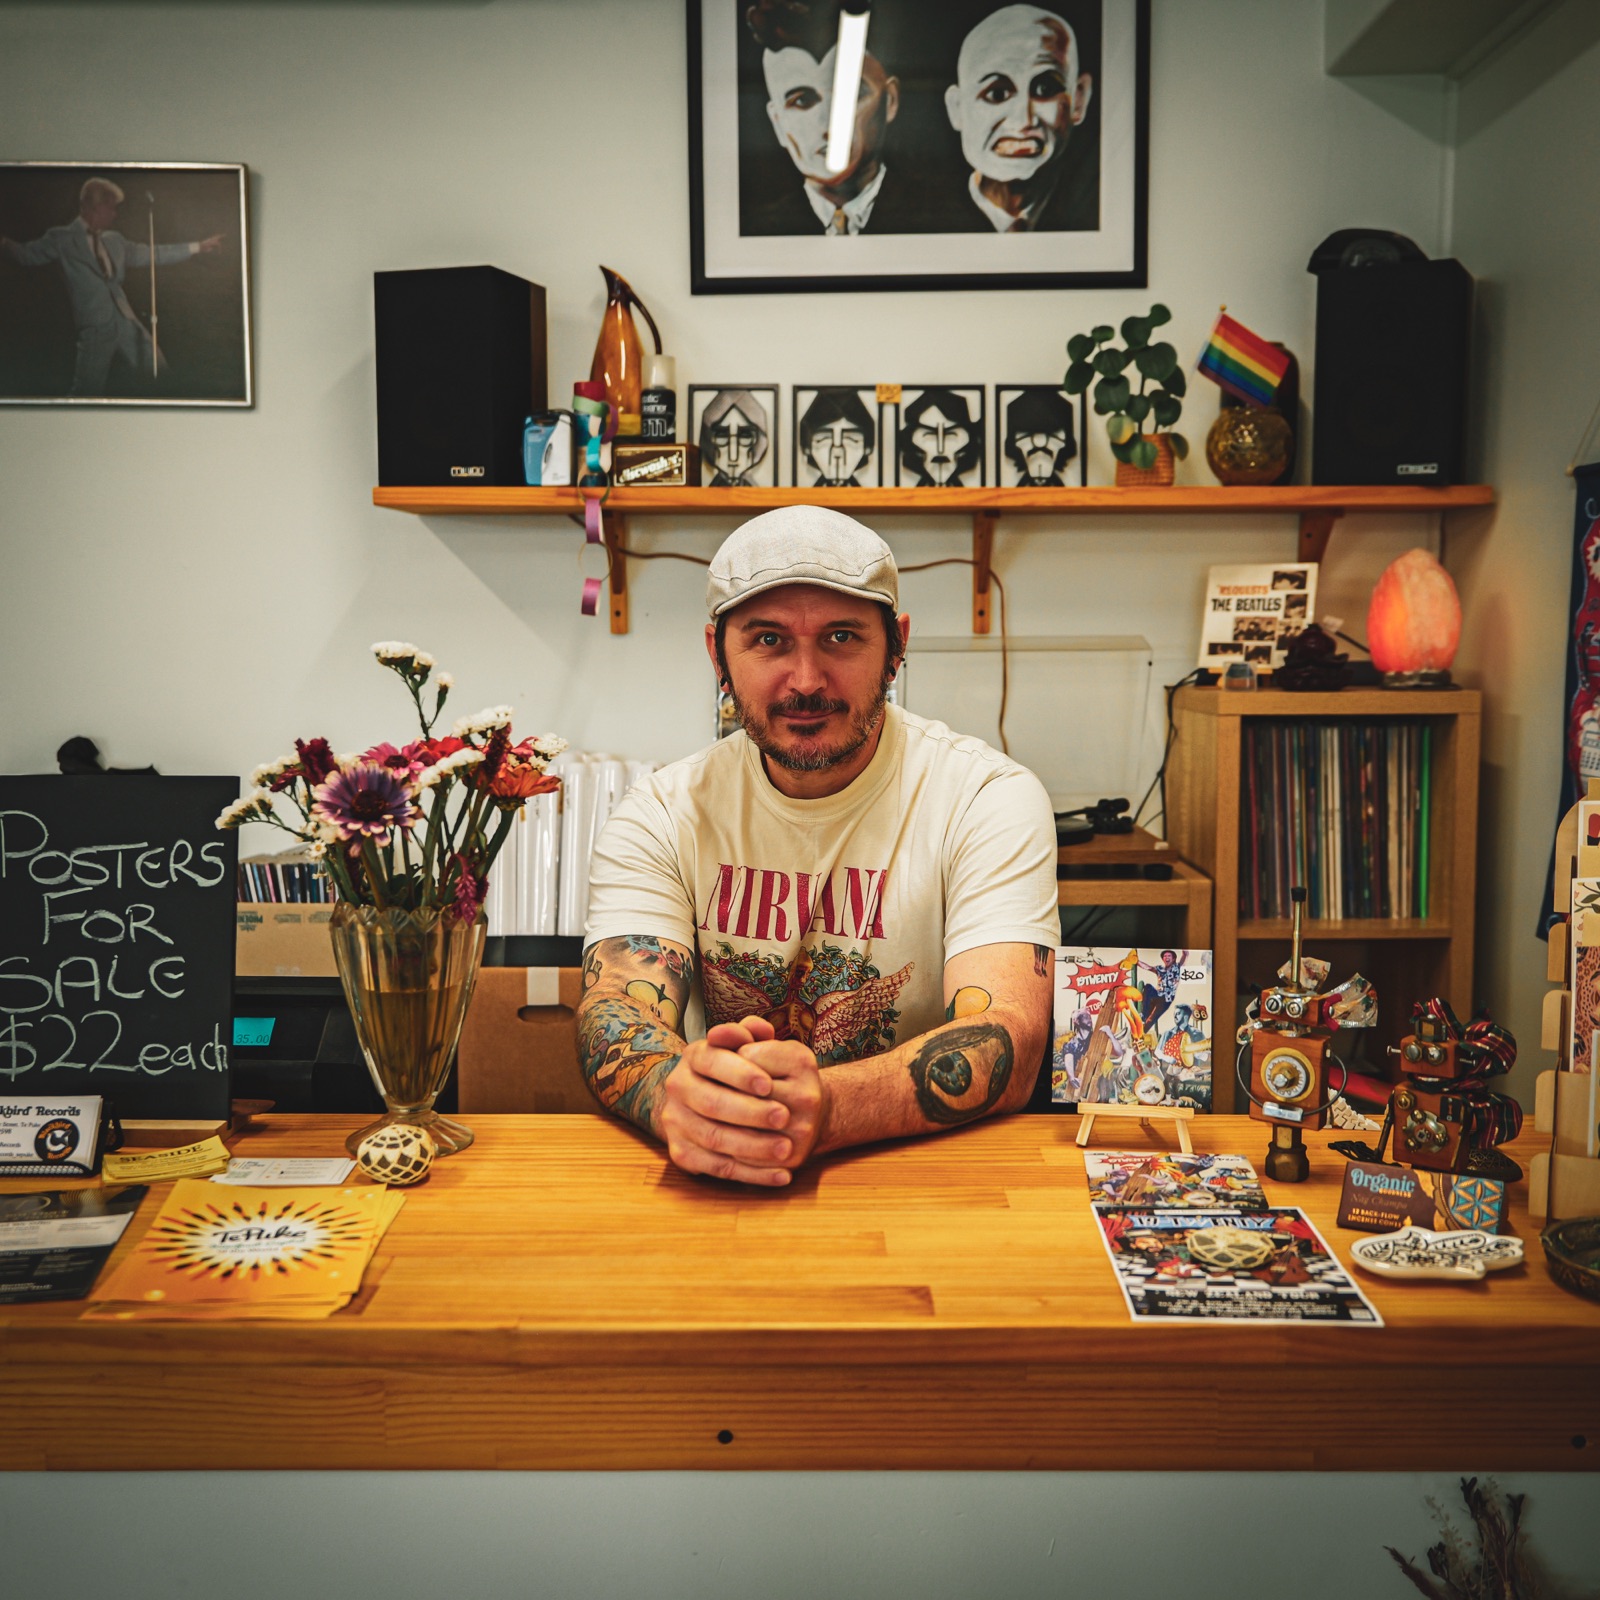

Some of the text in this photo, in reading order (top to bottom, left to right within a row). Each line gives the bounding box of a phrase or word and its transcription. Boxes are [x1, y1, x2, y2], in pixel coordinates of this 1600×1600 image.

[1211, 598, 1282, 611] THE BEATLES
[0, 810, 225, 888] POSTERS
[698, 862, 888, 942] NIRVANA
[43, 887, 174, 944] FOR
[0, 955, 186, 1013] SALE
[1181, 968, 1204, 981] $20
[137, 1022, 229, 1076] each
[235, 1033, 270, 1045] 35.00
[35, 1106, 81, 1116] Records
[119, 1145, 204, 1164] SEASIDE
[1350, 1168, 1416, 1193] Organic
[1169, 1216, 1271, 1229] TWENTY
